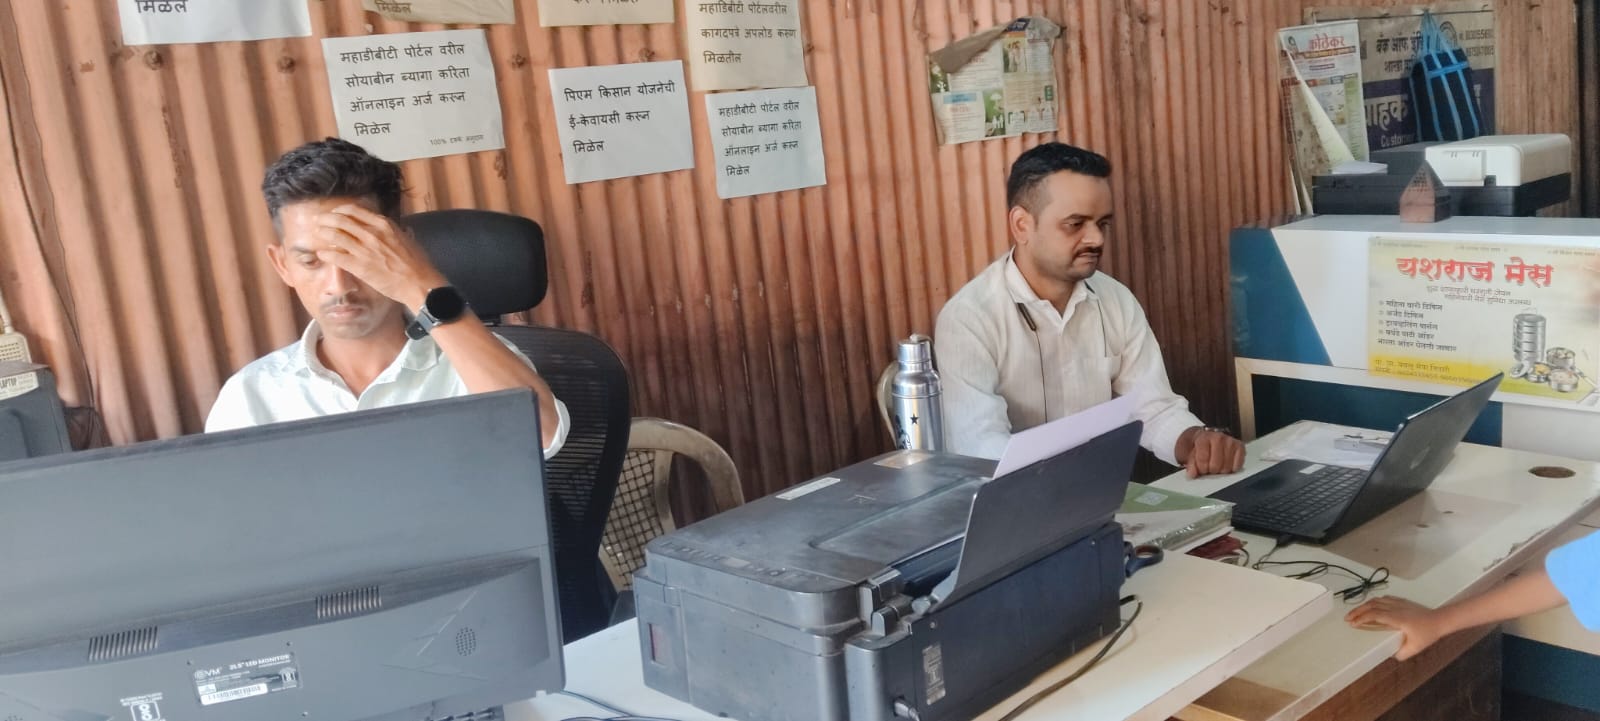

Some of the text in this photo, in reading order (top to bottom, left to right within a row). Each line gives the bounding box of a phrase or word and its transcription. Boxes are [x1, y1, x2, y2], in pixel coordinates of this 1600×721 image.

[340, 41, 465, 63] महाडीबीटी पोर्टल वरील
[703, 50, 742, 63] मिळतील
[344, 65, 470, 88] सोयाबीन ब्यागा करिता
[564, 80, 675, 101] पिएम किसान योजनेची
[350, 96, 405, 112] ऑनलाइन
[412, 91, 432, 106] अर्ज
[783, 100, 800, 110] वरील
[569, 110, 620, 129] ई-केवायसी
[354, 122, 391, 136] मिळेल
[721, 123, 754, 136] सोयाबीन
[573, 139, 604, 153] मिळेल
[726, 165, 750, 176] मिळेल
[1395, 256, 1553, 288] यशराज मेस
[258, 653, 290, 664] MONITOR
